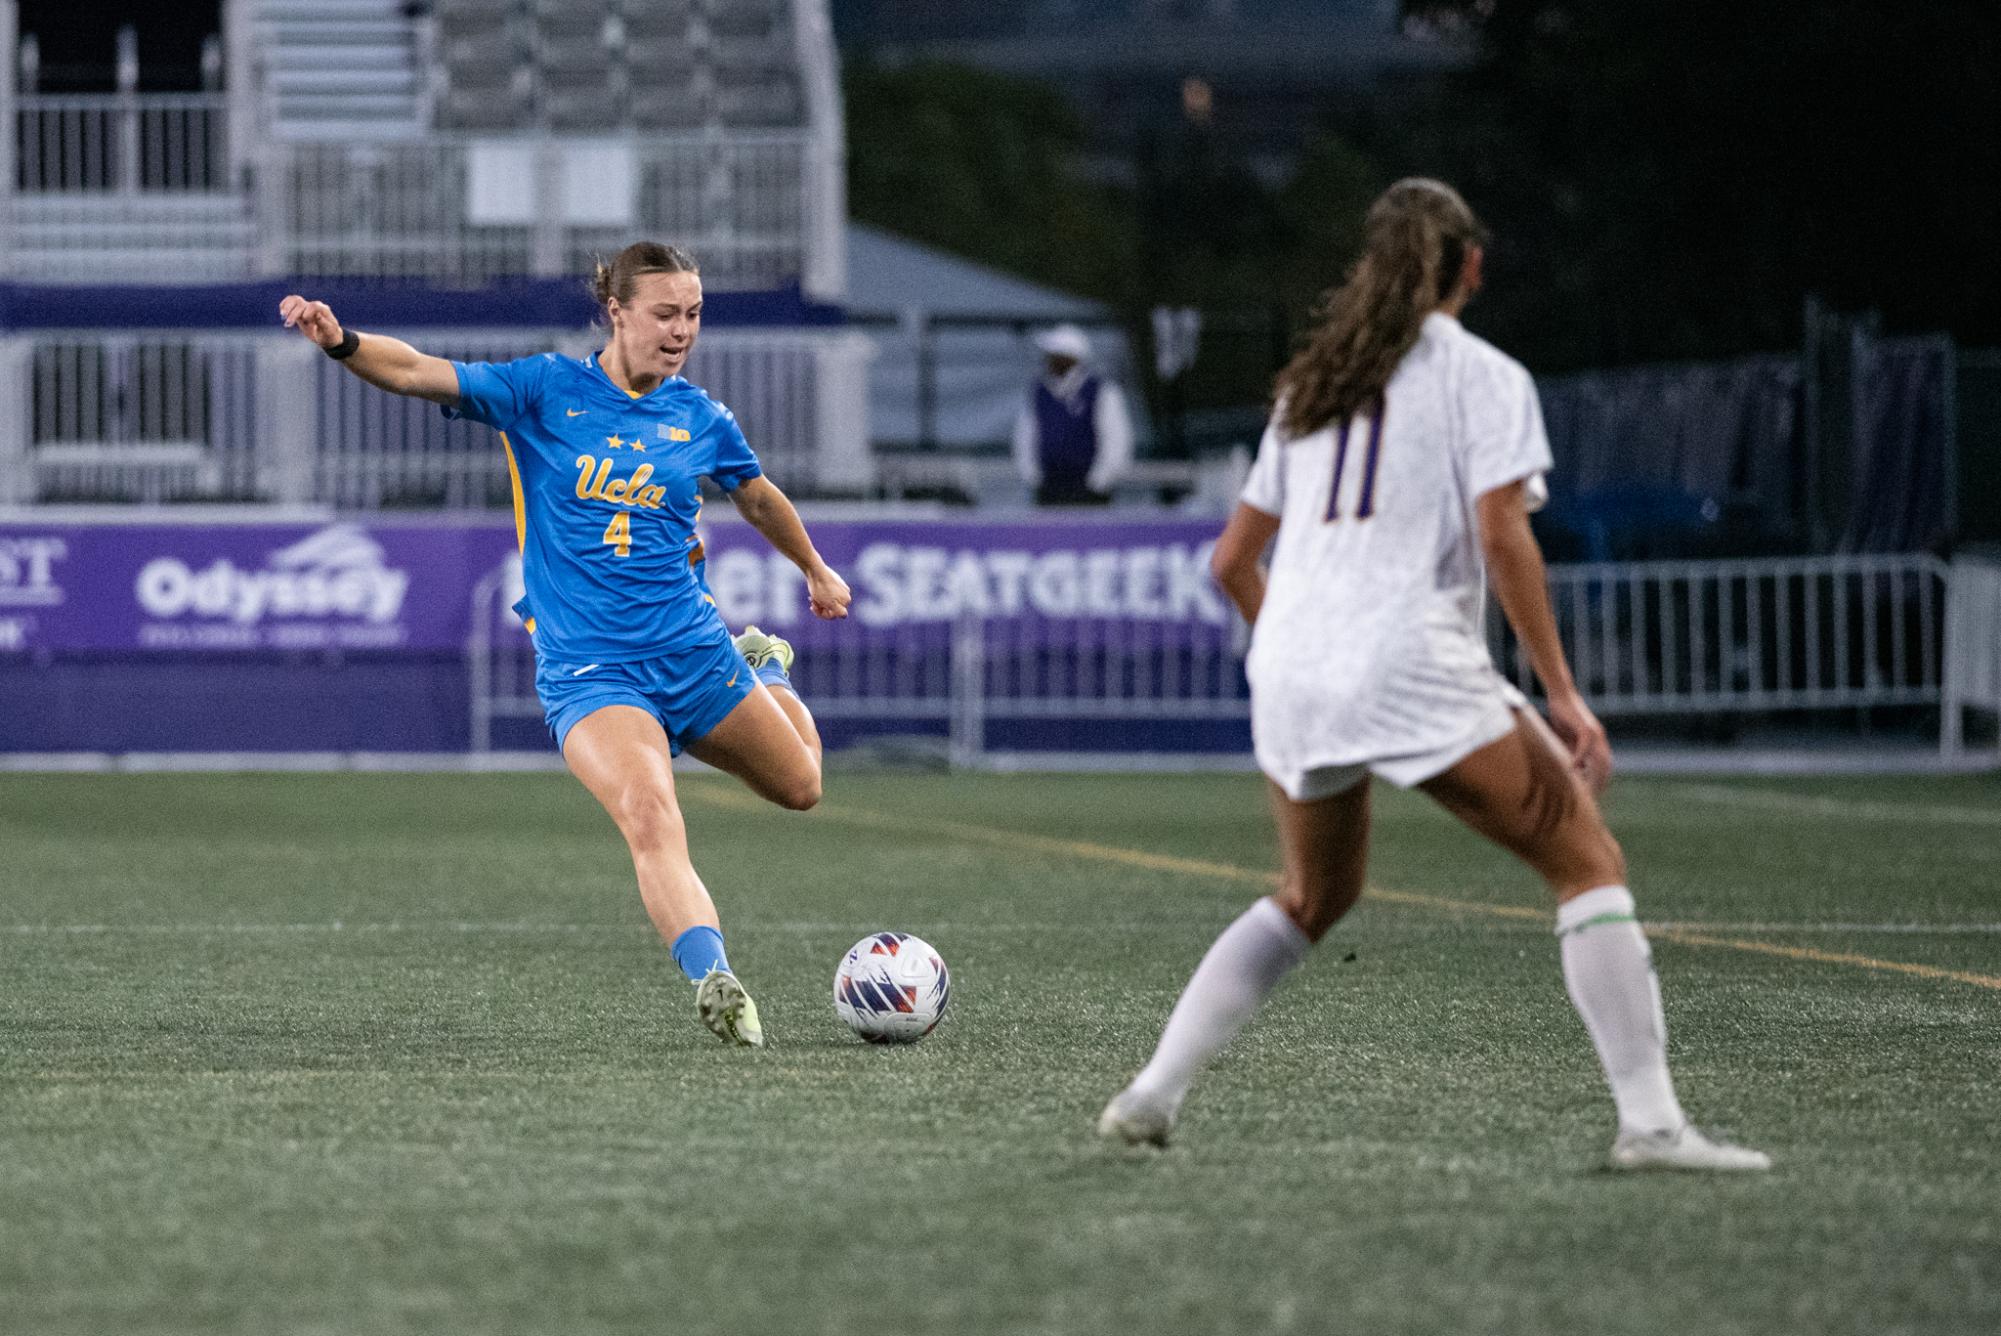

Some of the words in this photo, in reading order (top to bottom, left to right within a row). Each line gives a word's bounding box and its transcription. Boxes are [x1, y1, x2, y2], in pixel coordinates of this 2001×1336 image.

[602, 510, 632, 557] 4
[136, 557, 408, 624] Odyssey
[856, 541, 1229, 628] SEATGEEK
